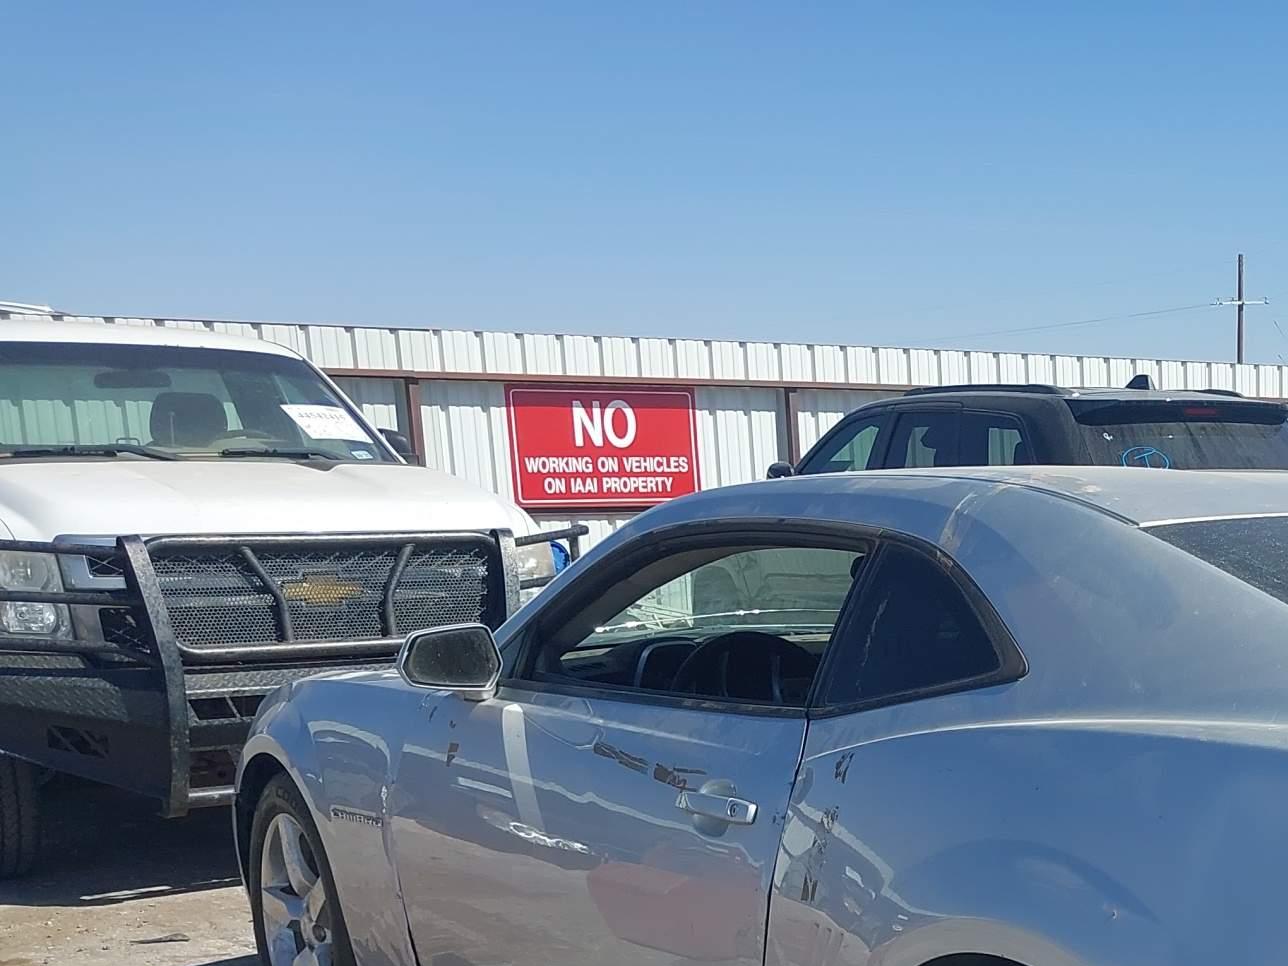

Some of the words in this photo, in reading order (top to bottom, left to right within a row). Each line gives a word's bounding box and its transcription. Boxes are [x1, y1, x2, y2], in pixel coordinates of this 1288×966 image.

[572, 400, 637, 448] NO
[525, 457, 593, 473] WORKING
[597, 457, 618, 473] ON
[623, 457, 688, 473] VEHICLES
[544, 477, 566, 494] ON
[571, 477, 598, 493] IAAI
[602, 477, 673, 493] PROPERTY
